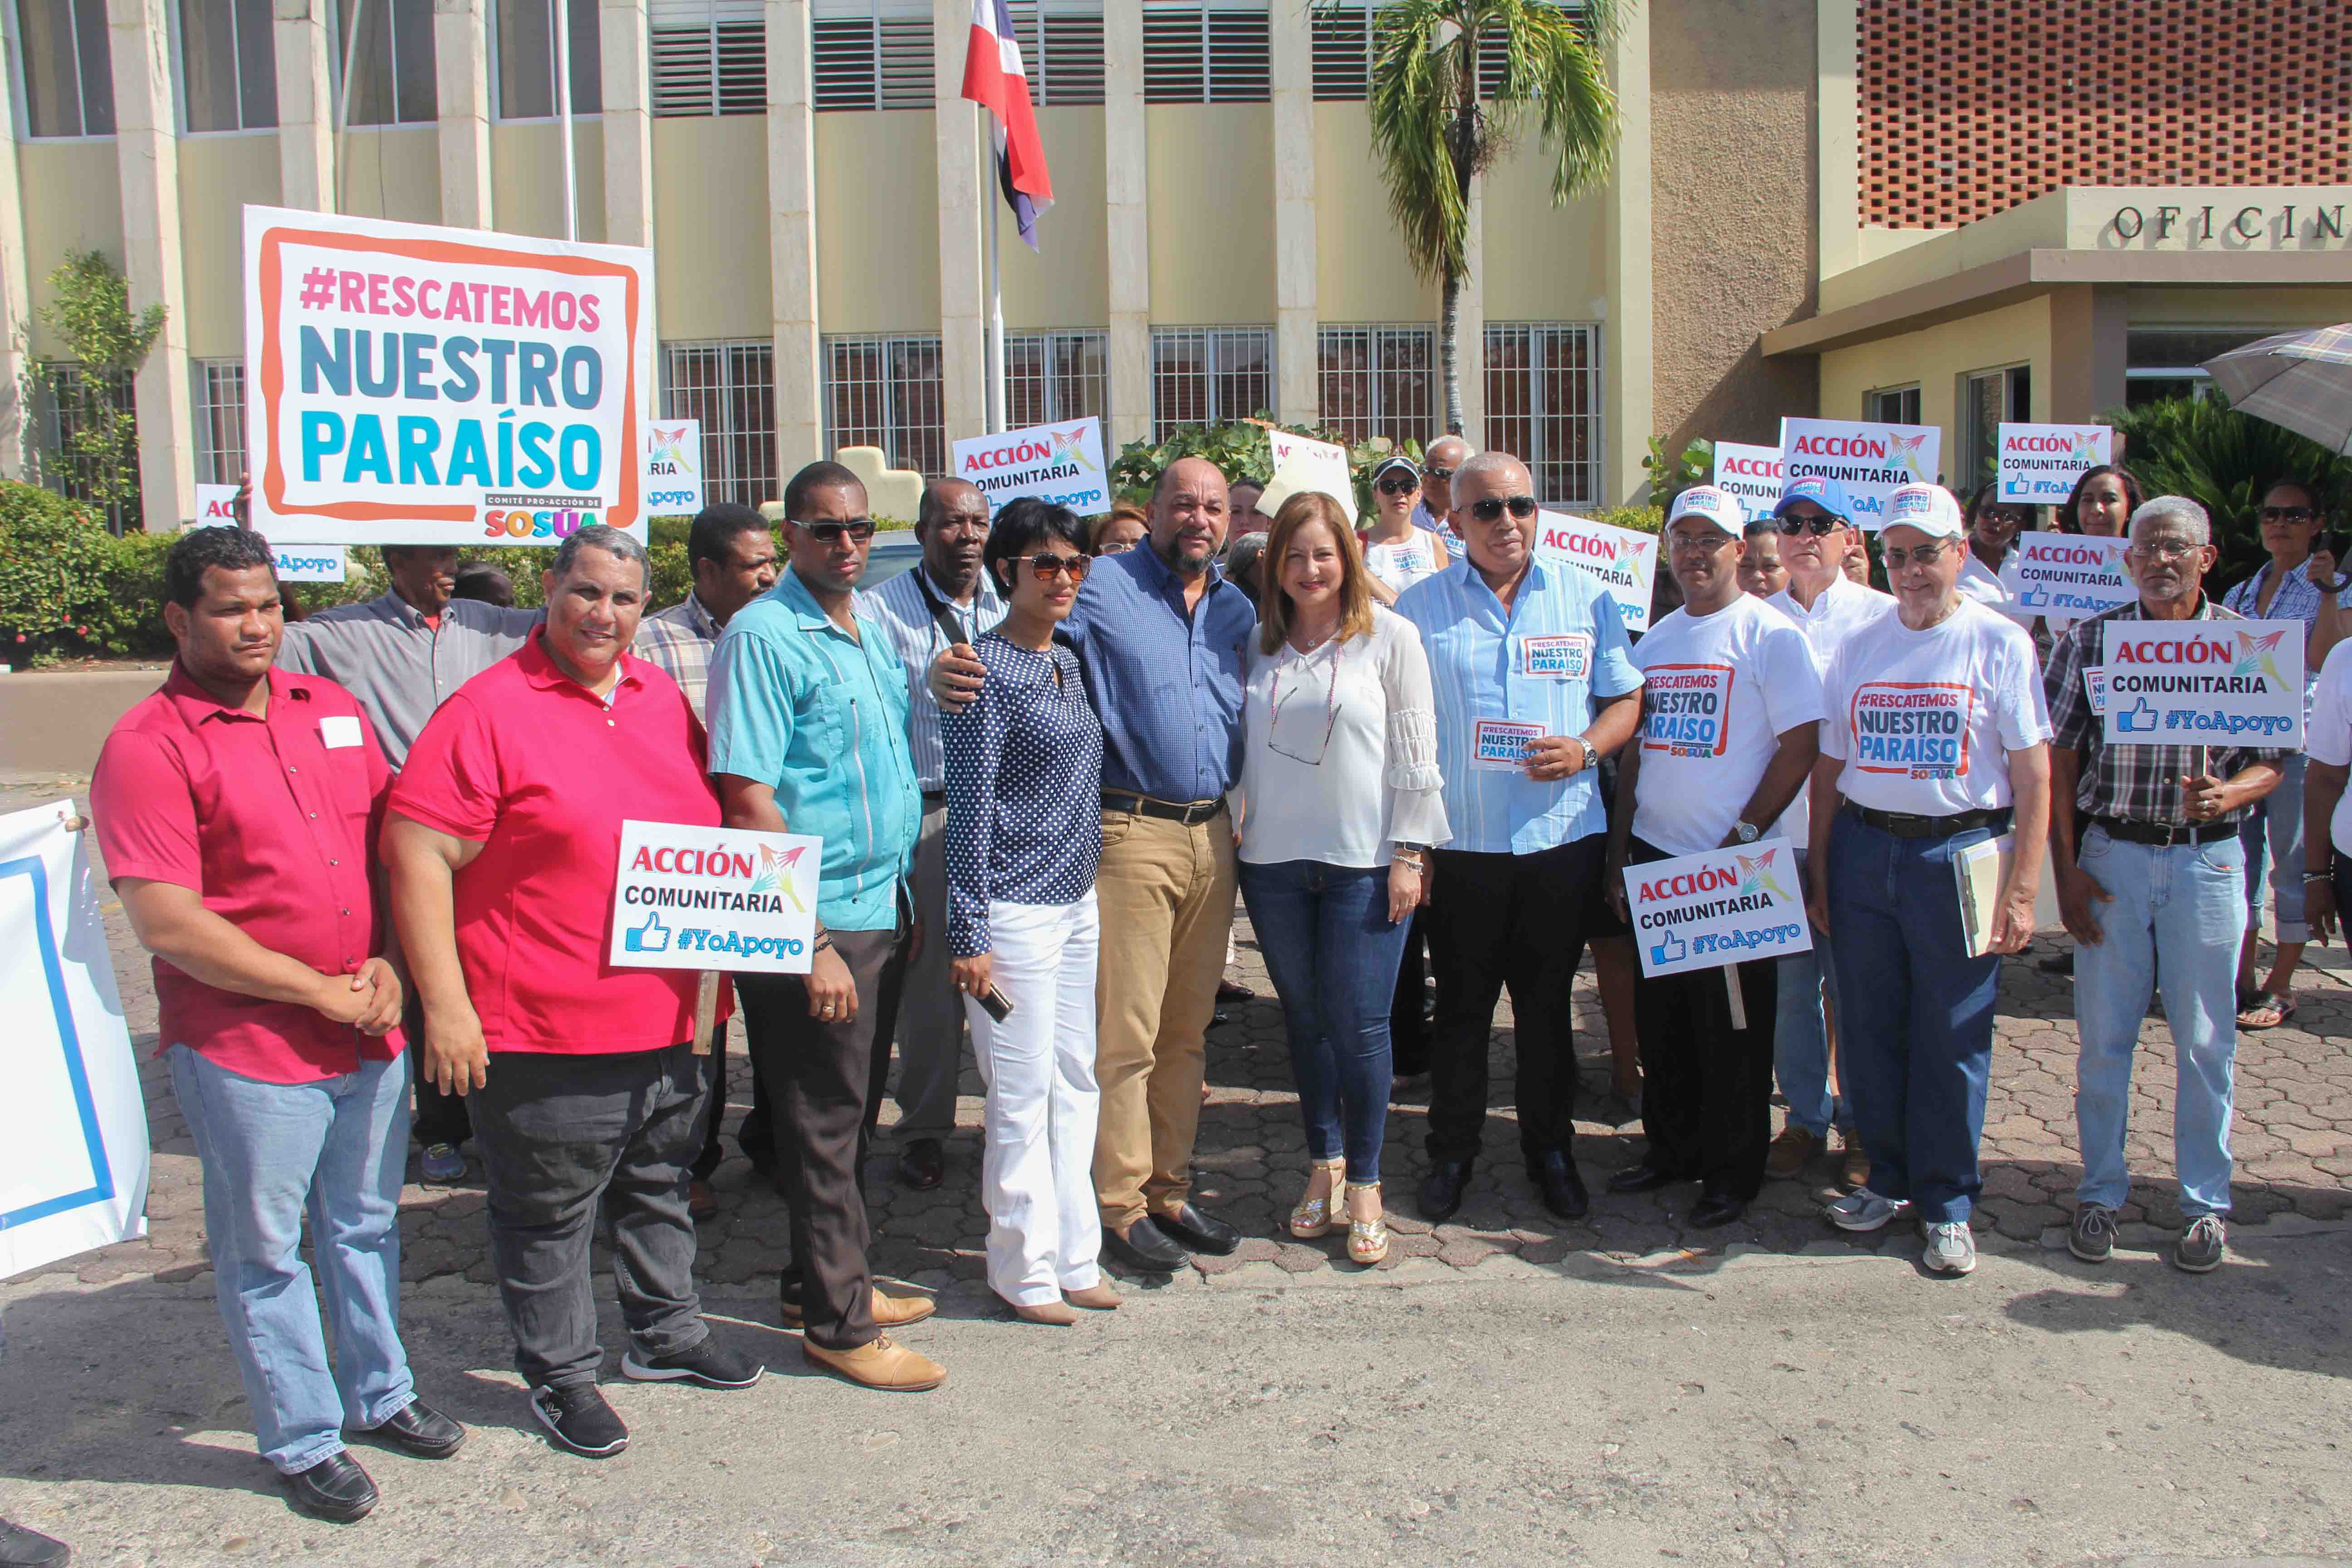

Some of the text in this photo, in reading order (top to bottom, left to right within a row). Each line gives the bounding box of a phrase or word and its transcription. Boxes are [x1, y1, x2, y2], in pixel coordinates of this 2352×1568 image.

[299, 266, 601, 333] #RESCATEMOS
[300, 325, 603, 410] NUESTRO
[300, 408, 603, 491] PARAÍSO
[964, 438, 1051, 473] ACCIÓN
[1793, 433, 1886, 459] ACCIÓN
[2005, 433, 2073, 452] ACCIÓN
[1723, 457, 1784, 479] ACCIÓ
[1789, 464, 1910, 484] COMUNITARIA
[2004, 458, 2091, 470] COMUNITARIA
[975, 463, 1080, 492] OMUNITARIA
[1720, 481, 1781, 499] COMUNI
[527, 498, 585, 506] PRO-ACCIÓN
[1543, 528, 1616, 560] ACCIÓN
[2025, 544, 2103, 565] ACCIÓN
[274, 554, 338, 573] Apoyo
[2021, 568, 2122, 587] COMUNITARIA
[1532, 648, 1583, 658] NUESTRO
[2114, 633, 2233, 664] ACCIÓN
[2112, 676, 2268, 694] COMUNITARIA
[1859, 693, 1958, 708] #RESCATEMOS
[1483, 725, 1539, 736] #RESCATEMOS
[1645, 714, 1715, 742] ARAÍSO
[1859, 710, 1959, 735] NUESTRO
[2166, 710, 2293, 735] #YoApoyo
[1859, 734, 1956, 763] PARAÍSO
[629, 843, 755, 879] ACCIÓN
[1639, 865, 1738, 904] ACCIÓN
[625, 885, 784, 913] COMUNITARIA
[1640, 892, 1774, 929] COMUNITARIA
[678, 928, 804, 959] #YoApoyo
[1692, 923, 1800, 954] #YoApoyo
